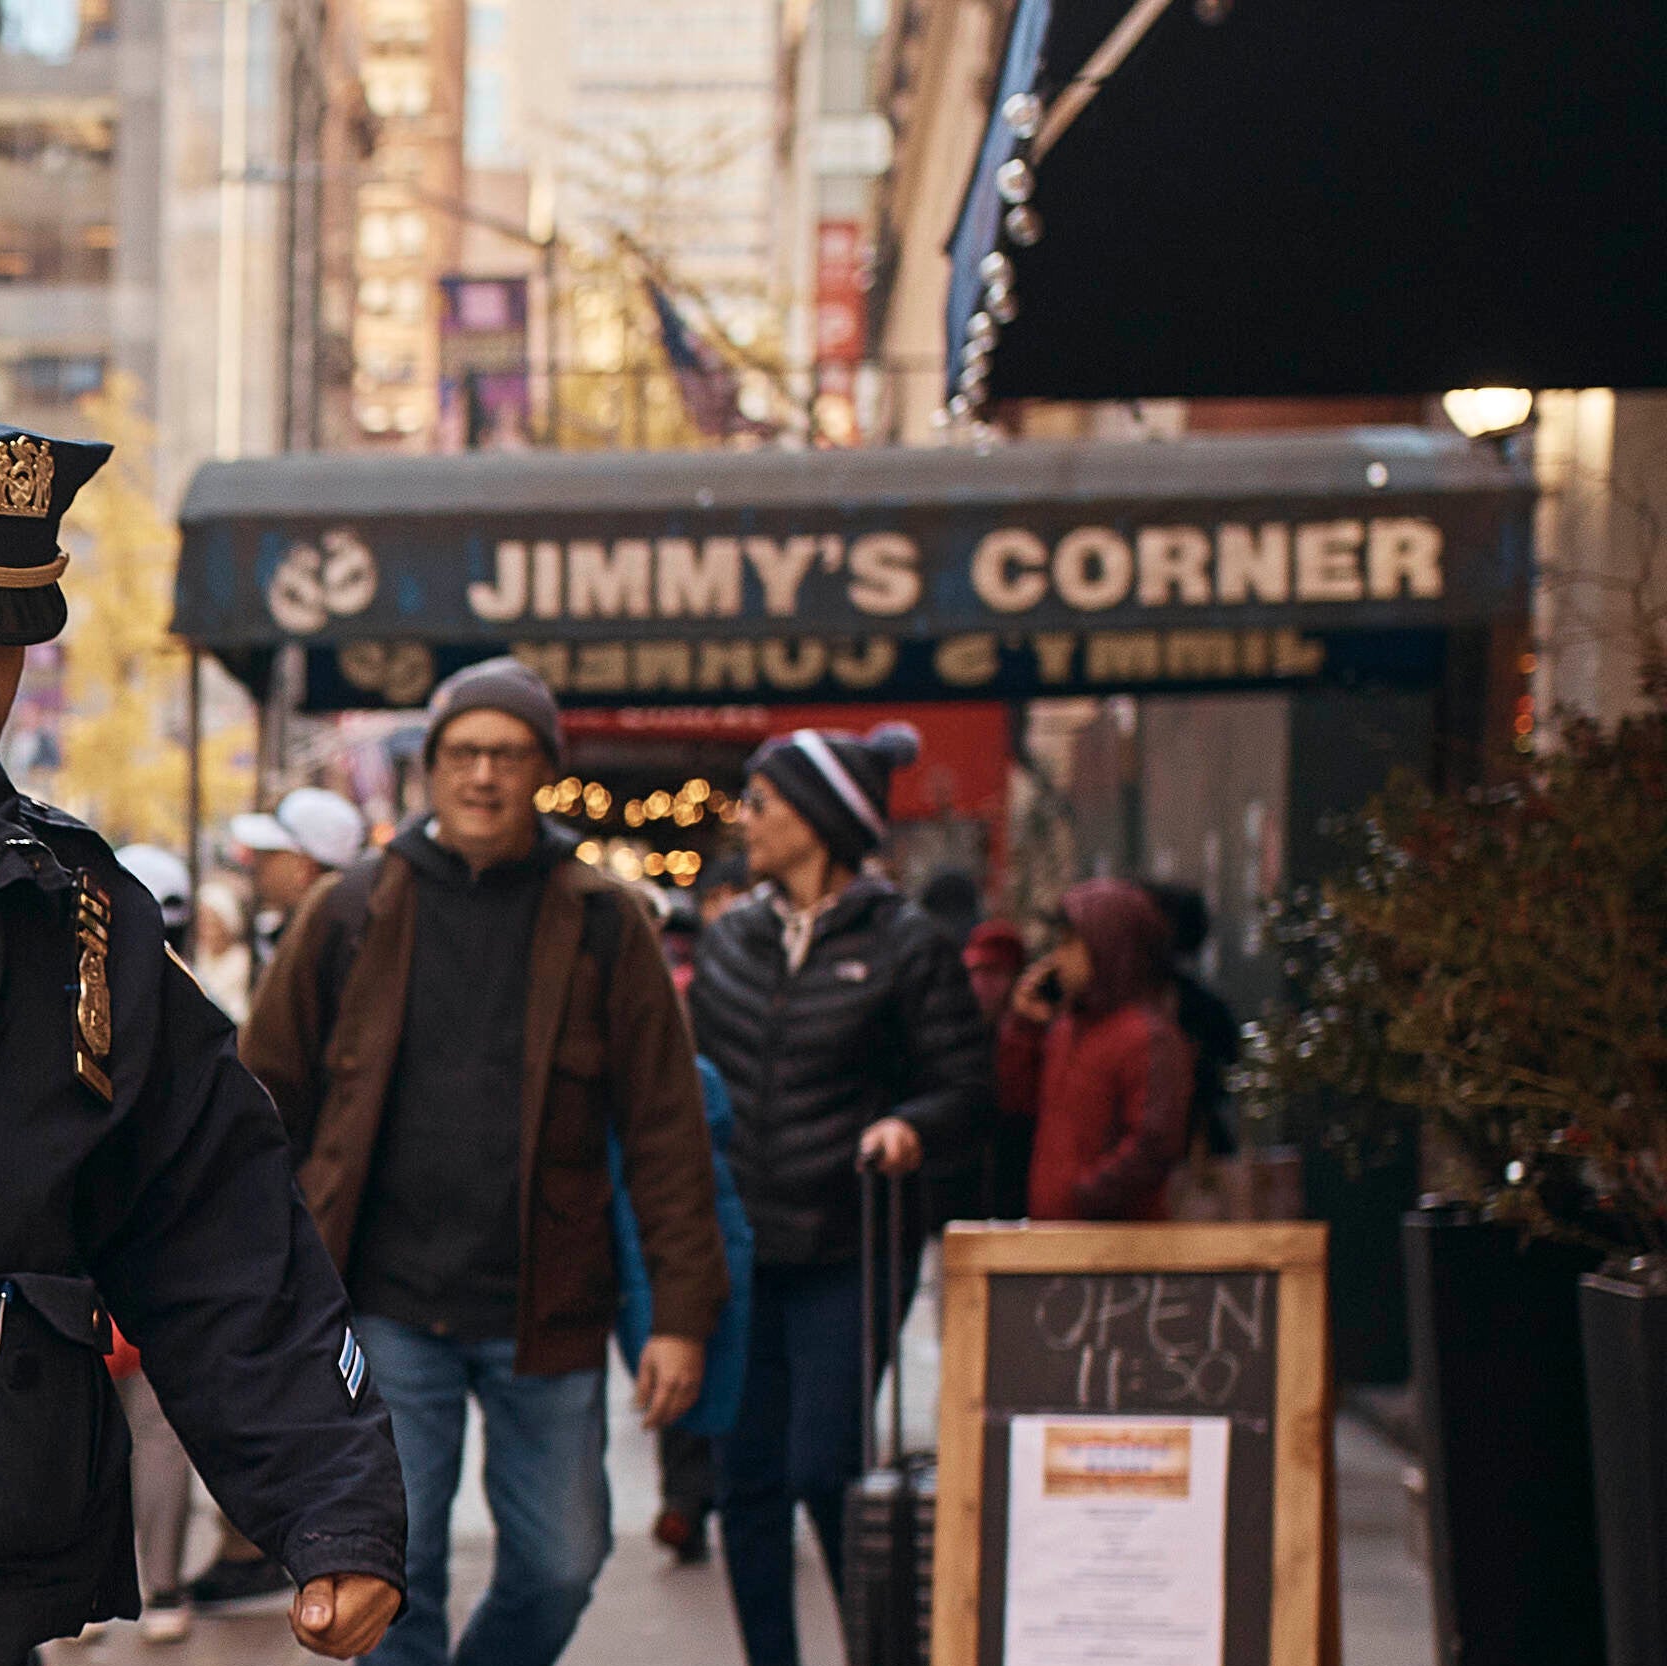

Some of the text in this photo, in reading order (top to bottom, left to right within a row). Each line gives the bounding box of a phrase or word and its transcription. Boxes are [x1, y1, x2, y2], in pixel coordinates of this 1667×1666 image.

[467, 517, 1445, 621] JIMMY'S CORNER
[1033, 1274, 1269, 1358] OPEN
